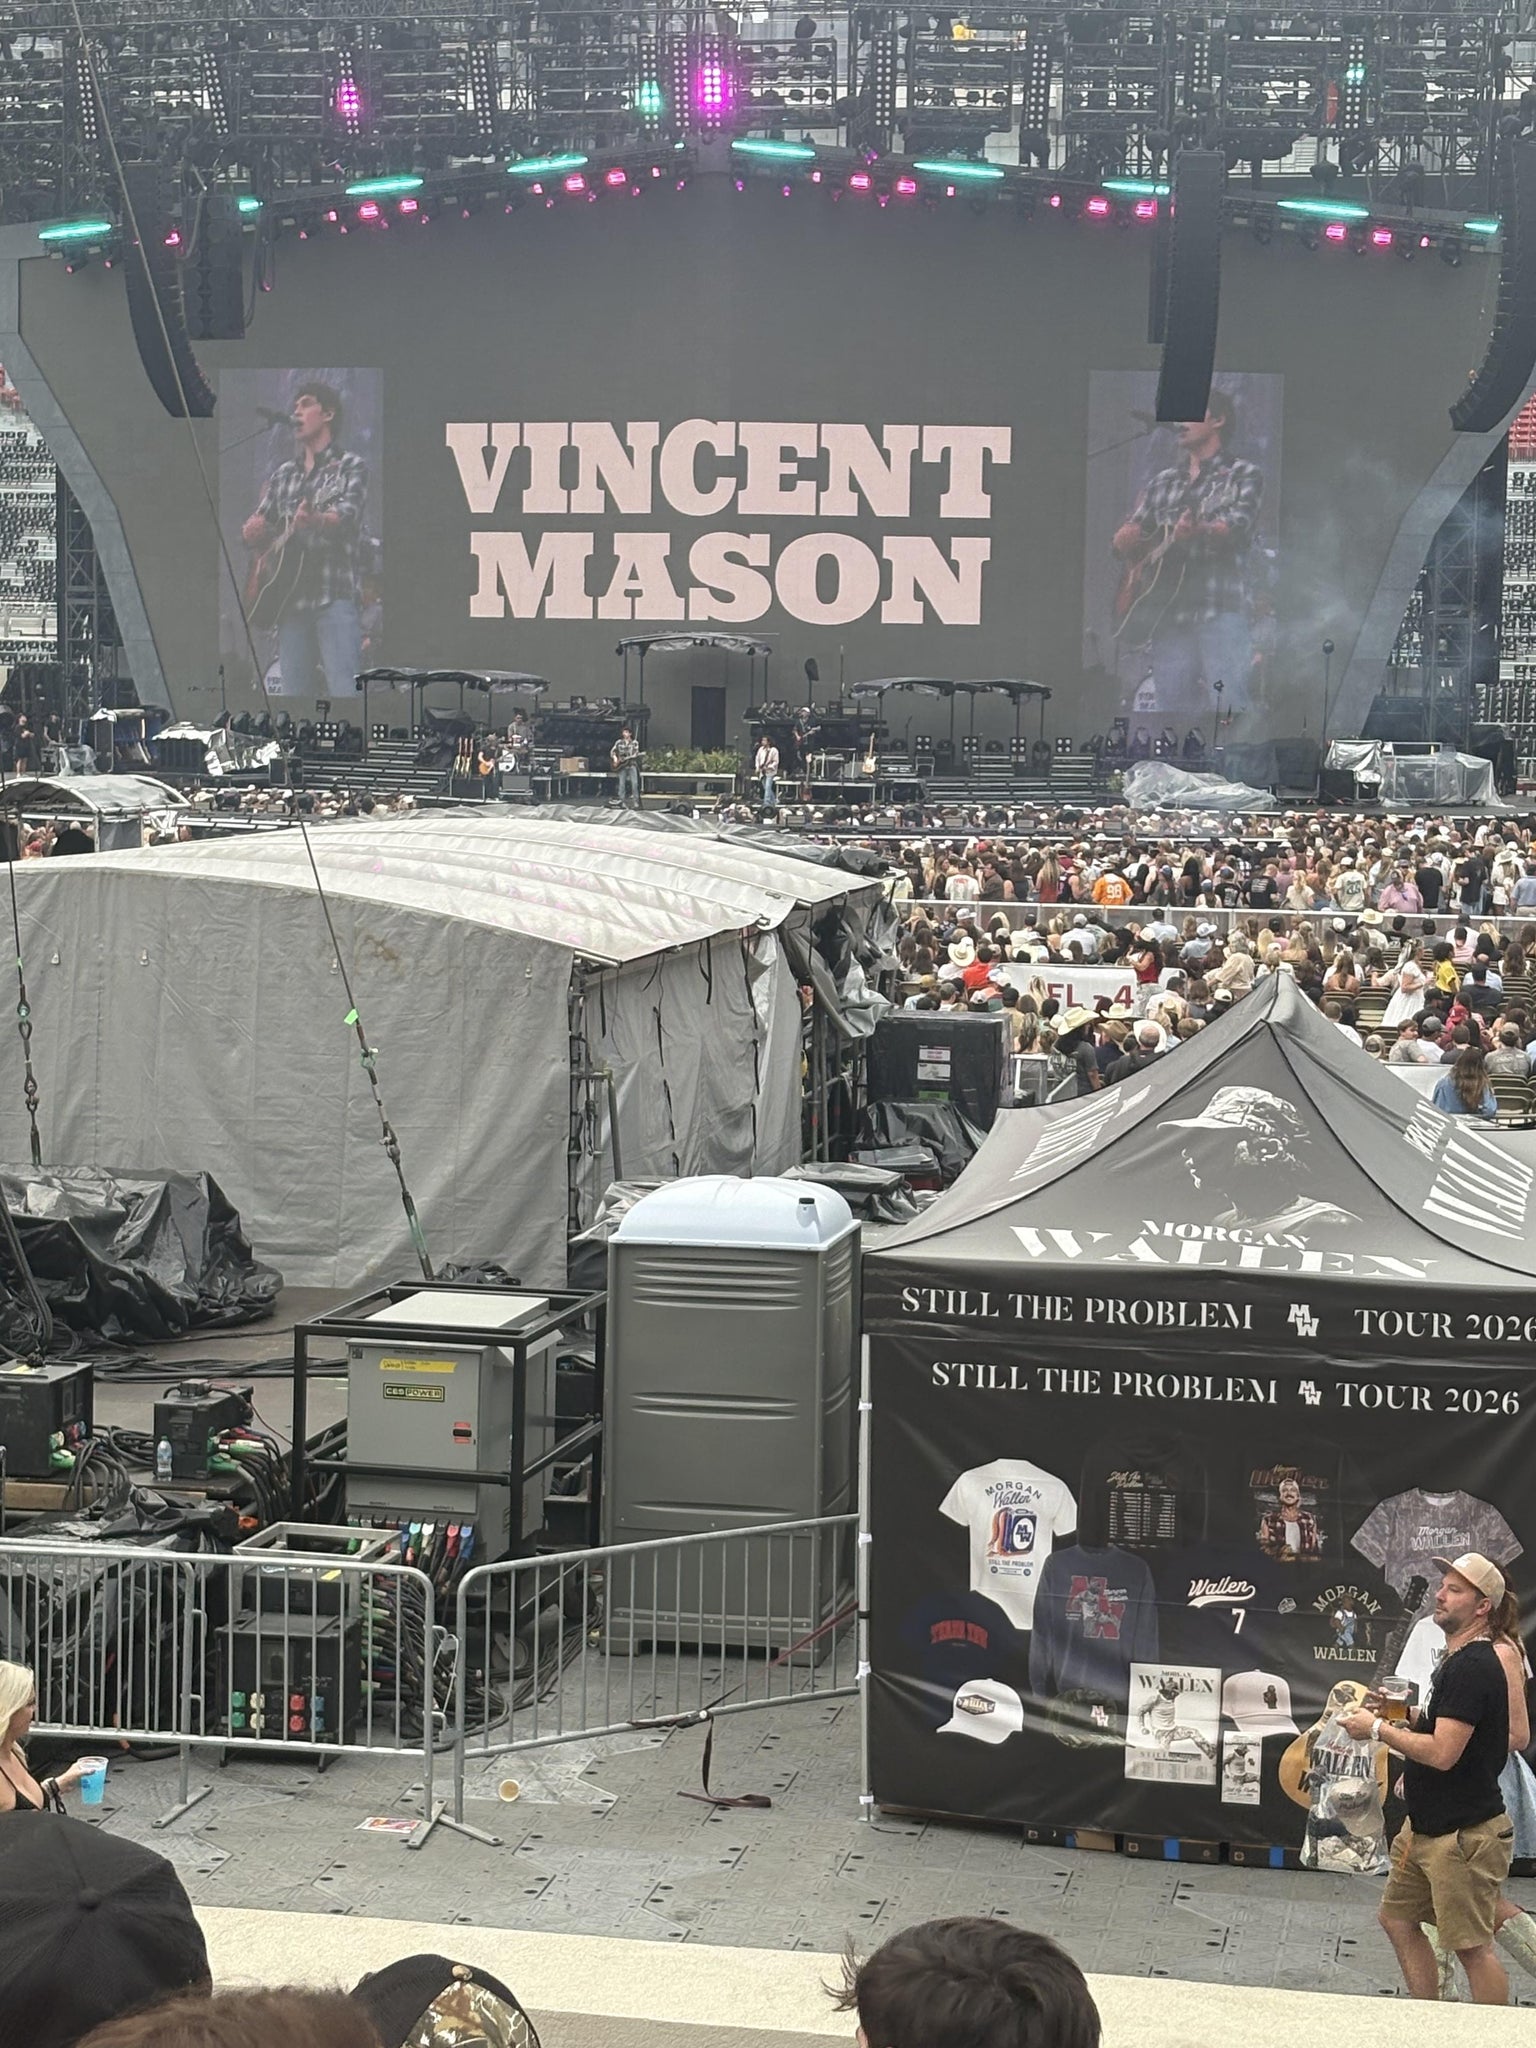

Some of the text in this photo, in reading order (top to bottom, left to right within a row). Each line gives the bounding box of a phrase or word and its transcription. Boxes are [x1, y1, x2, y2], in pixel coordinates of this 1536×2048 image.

[446, 419, 1011, 518] VINCENT
[470, 532, 991, 625] MASON
[1106, 883, 1121, 899] 98
[1114, 985, 1134, 1010] 4
[1141, 1220, 1311, 1251] MORGAN
[1010, 1225, 1439, 1279] WALLEN
[901, 1286, 999, 1318] STILL
[1008, 1293, 1073, 1322] THE
[1085, 1297, 1253, 1330] PROBLEM
[1354, 1309, 1455, 1340] TOUR
[1466, 1314, 1536, 1342] 2026
[406, 1388, 441, 1398] POWER
[931, 1361, 1028, 1391] STILL
[1037, 1367, 1101, 1394] THE
[1112, 1371, 1278, 1405] PROBLEM
[1336, 1382, 1434, 1411] TOUR
[1444, 1388, 1520, 1415] 2026
[985, 1481, 1042, 1500] MORGAN
[993, 1491, 1032, 1508] Wallen
[1418, 1526, 1458, 1537] Morgan
[1187, 1576, 1256, 1599] Wallen
[1312, 1585, 1382, 1616] MORGAN
[1231, 1608, 1246, 1635] 7
[1313, 1646, 1377, 1663] WALLEN
